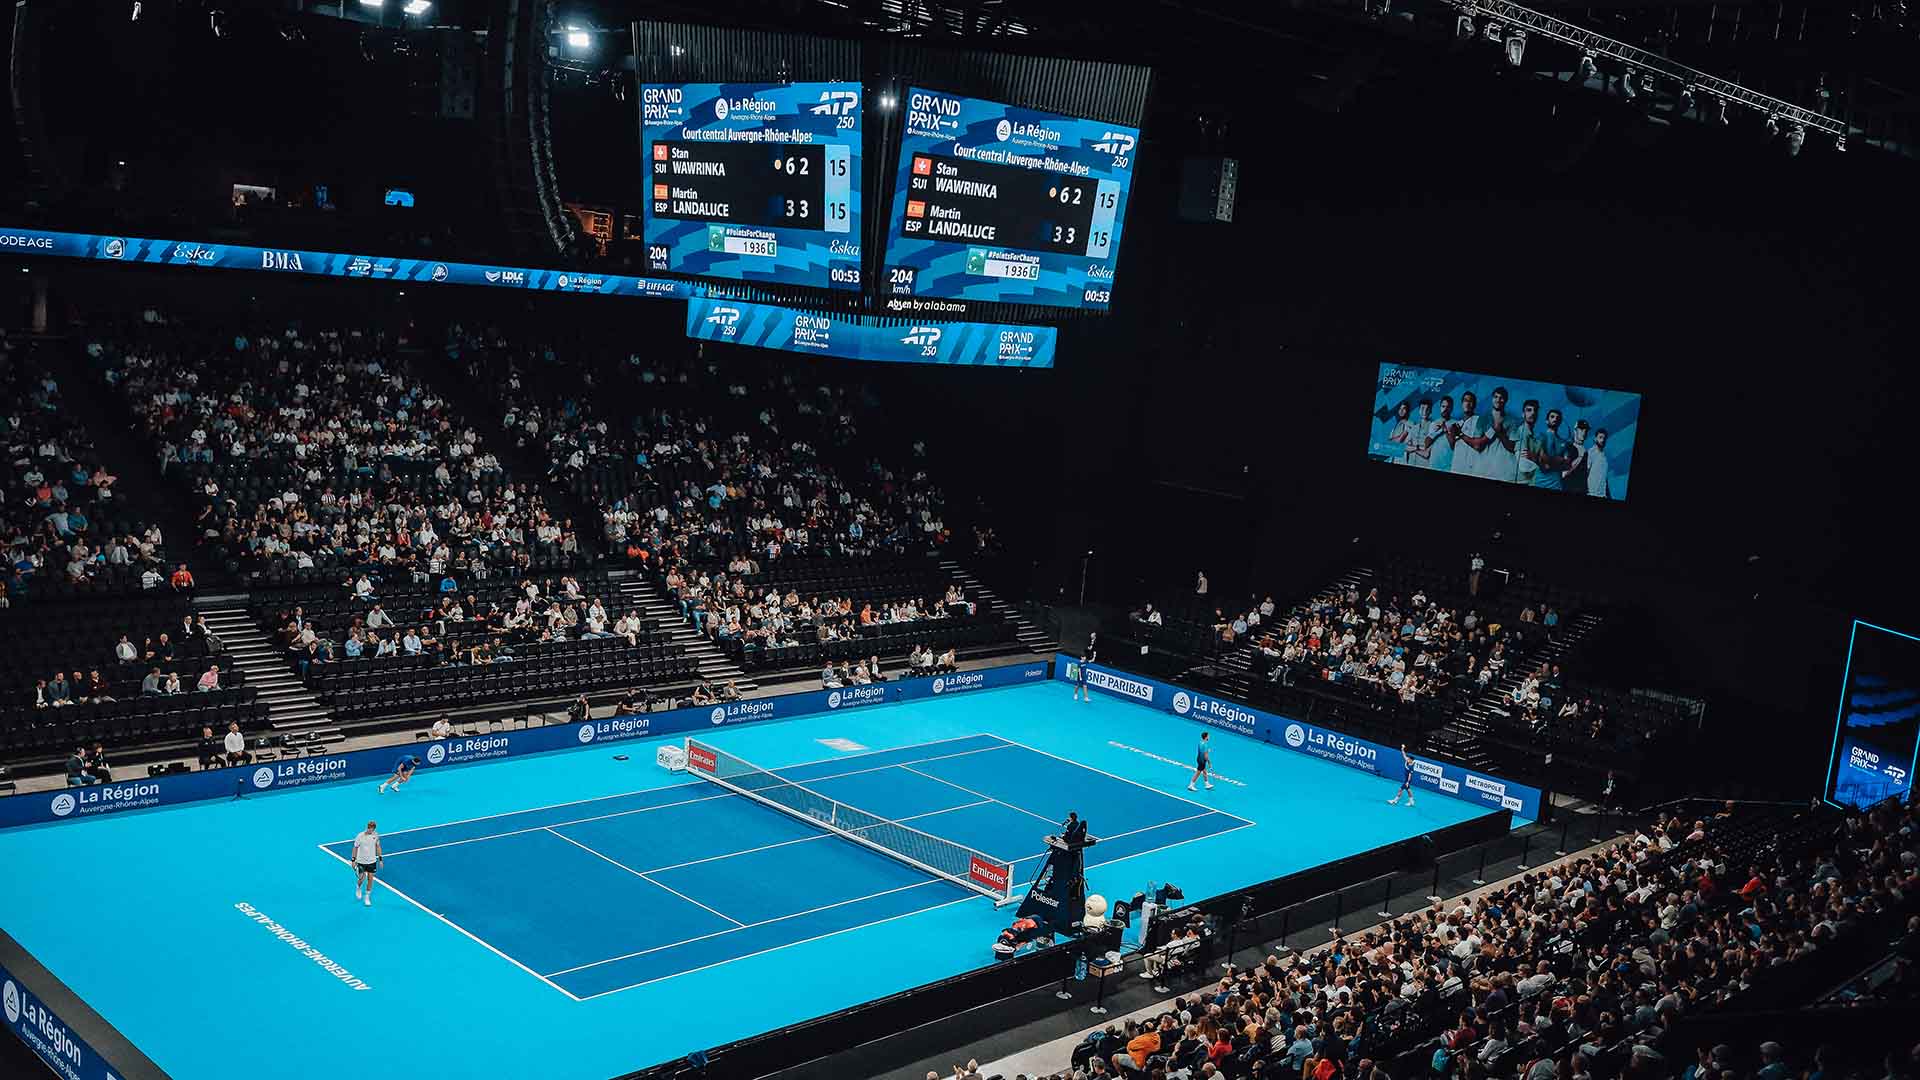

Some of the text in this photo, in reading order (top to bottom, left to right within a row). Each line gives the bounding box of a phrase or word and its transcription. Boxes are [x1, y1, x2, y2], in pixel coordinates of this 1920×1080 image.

[644, 88, 682, 103] GRAND
[809, 91, 858, 115] ATP
[644, 104, 669, 119] PRIX
[730, 97, 776, 114] La Région
[911, 93, 961, 117] GRAND
[836, 116, 855, 129] 250
[908, 111, 941, 131] PRIX
[682, 127, 813, 144] Court central Auvergne-Rhône-Alpes
[1013, 121, 1061, 143] La Région
[1091, 131, 1135, 156] ATP
[672, 147, 689, 159] Stan
[953, 143, 1090, 177] Court central Auvergne-Rhône-Alpes
[655, 157, 846, 177] SUI WAWRINKA 6 2 15
[936, 162, 958, 177] Stan
[1112, 156, 1129, 169] 250
[672, 187, 698, 200] Martin
[912, 177, 1115, 209] SUI WAWRINKA 6 2 15
[655, 200, 846, 220] ESP LANDALUCE 3 3 15
[930, 205, 961, 220] Martin
[905, 220, 1108, 247] ESP LANDALUCE 3 3 15
[0, 235, 53, 249] ODEAGE
[830, 239, 860, 256] Eska
[173, 243, 216, 261] Eska
[650, 247, 667, 260] 204
[653, 261, 667, 270] km/h
[1088, 263, 1114, 279] Eska
[578, 277, 602, 286] Région
[831, 269, 860, 283] 00:53
[890, 269, 913, 284] 204
[646, 282, 675, 292] EIFFAGE
[892, 284, 911, 295] km/h
[1085, 290, 1110, 303] 00:53
[887, 299, 966, 313] Absen by alabama
[706, 306, 740, 325] ATP
[795, 315, 830, 330] GRAND
[723, 325, 736, 336] 250
[794, 328, 816, 341] PRIX
[900, 326, 941, 345] ATP
[1000, 331, 1033, 343] GRAND
[921, 346, 937, 356] 250
[999, 343, 1020, 355] PRIX
[945, 673, 983, 686] La Région
[1086, 670, 1148, 697] BNP PARIBAS
[842, 686, 884, 699] La Région
[727, 701, 774, 716] La Région
[1194, 696, 1256, 726] La Région
[597, 718, 650, 733] La Région
[1192, 712, 1254, 735] Auvergne-Rhône-Alpes
[448, 737, 508, 754] La Région
[1307, 728, 1377, 761] La Région
[1306, 745, 1375, 770] Auvergne-Rhône-Alpes
[1850, 755, 1868, 769] PRIX
[1851, 746, 1879, 763] GRAND
[278, 758, 346, 777] La Région
[1414, 762, 1440, 776] TROPOLE
[1883, 765, 1906, 778] ATP
[1420, 774, 1457, 791] GRAND LYON
[79, 783, 159, 804] La Région
[1481, 792, 1520, 809] GRAND LYON
[79, 797, 159, 814] Auvergne-Rhône-Alpes
[972, 863, 1005, 885] Emirates
[1031, 890, 1060, 908] Polestar
[22, 992, 81, 1067] La Région
